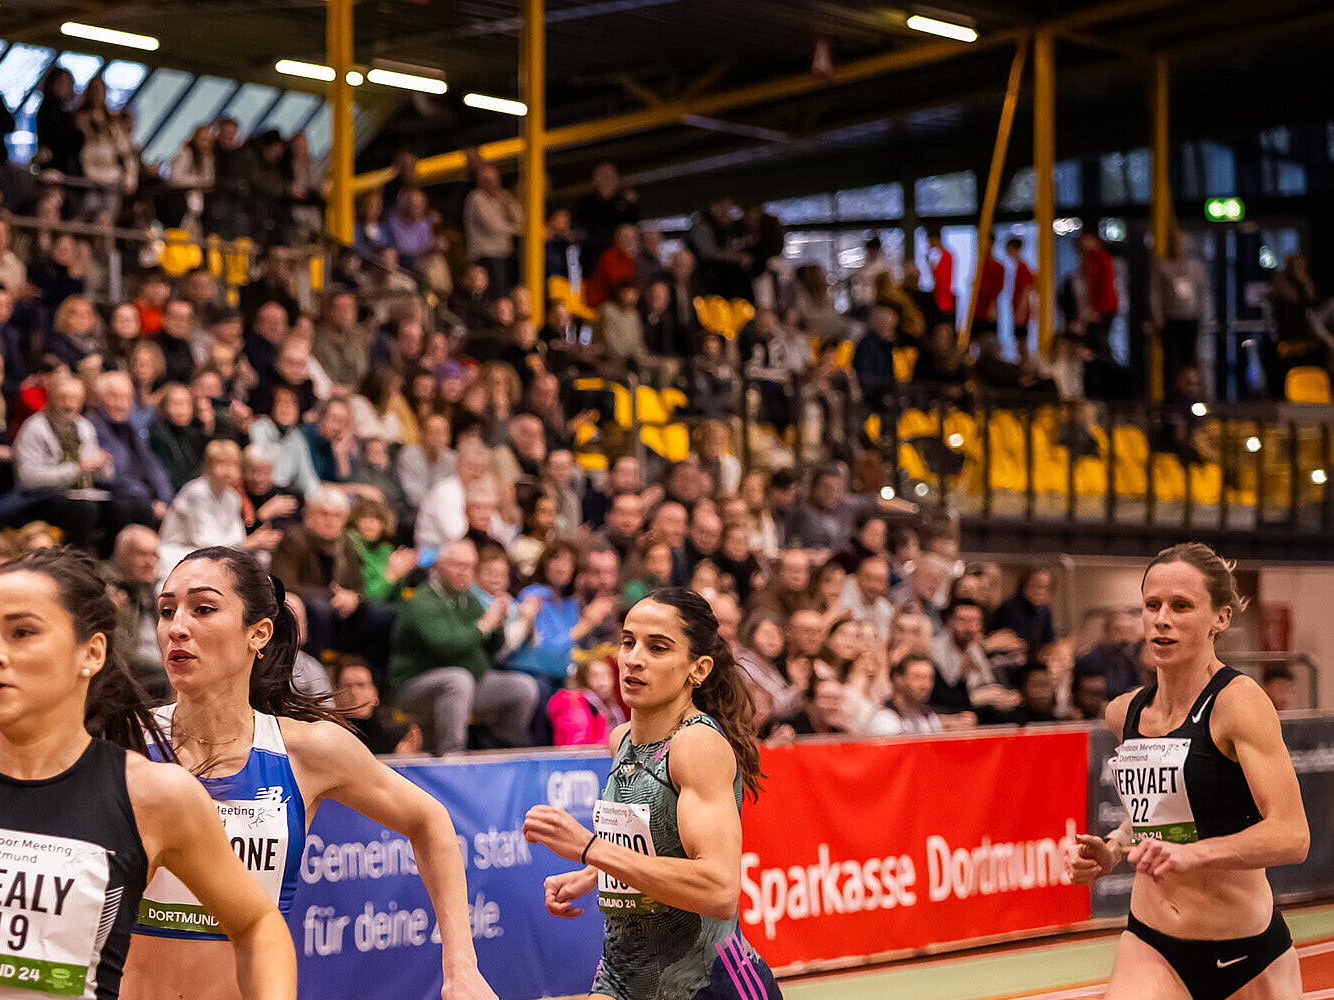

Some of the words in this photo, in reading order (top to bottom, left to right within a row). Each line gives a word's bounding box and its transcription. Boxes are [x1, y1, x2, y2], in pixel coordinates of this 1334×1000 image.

[1139, 743, 1165, 752] Meeting
[217, 806, 255, 818] eeting
[1131, 798, 1149, 822] 22
[22, 839, 72, 857] Meeting
[740, 842, 917, 940] Sparkasse
[926, 817, 1076, 902] Dortmund
[148, 908, 219, 926] DORTMUND
[303, 904, 351, 957] für
[354, 901, 429, 952] deine
[18, 966, 41, 982] 24
